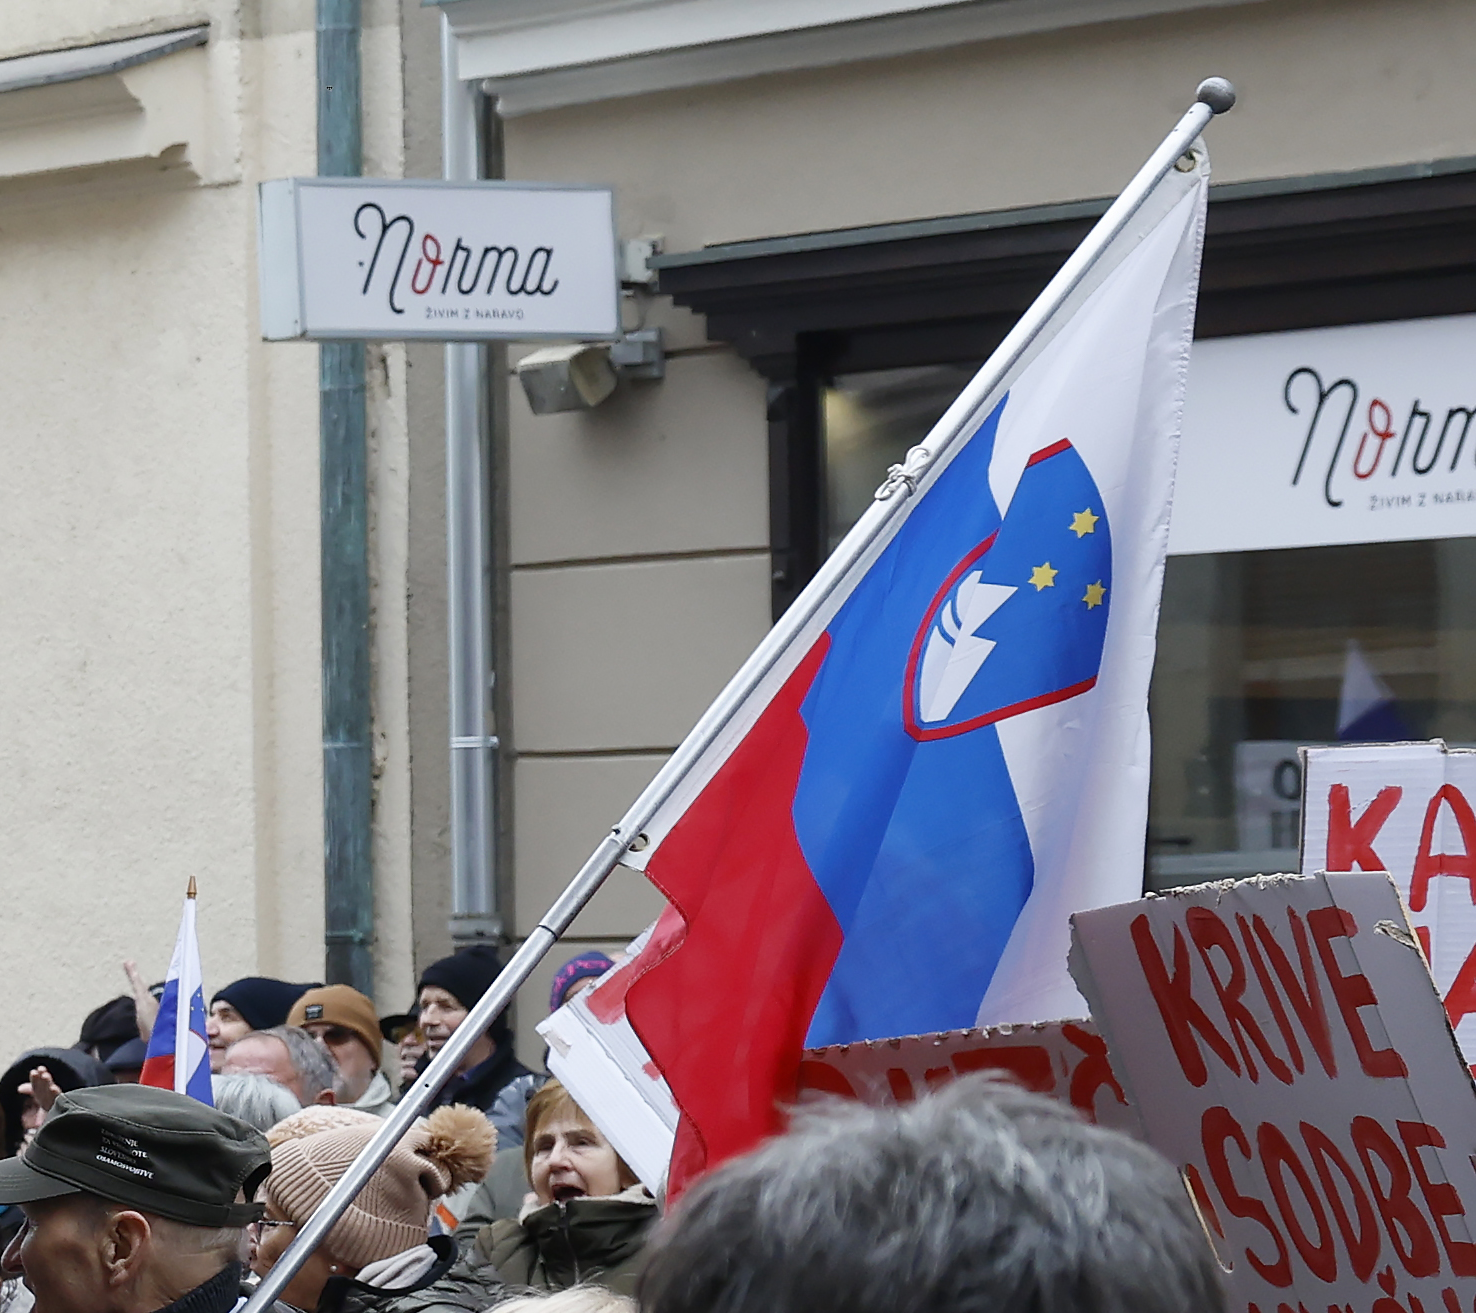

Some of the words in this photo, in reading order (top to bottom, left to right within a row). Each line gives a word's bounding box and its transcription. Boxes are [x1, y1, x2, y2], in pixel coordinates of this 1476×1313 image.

[353, 202, 560, 315] Norma
[1130, 905, 1409, 1089] KRIVE
[1201, 1105, 1476, 1288] SODBE
